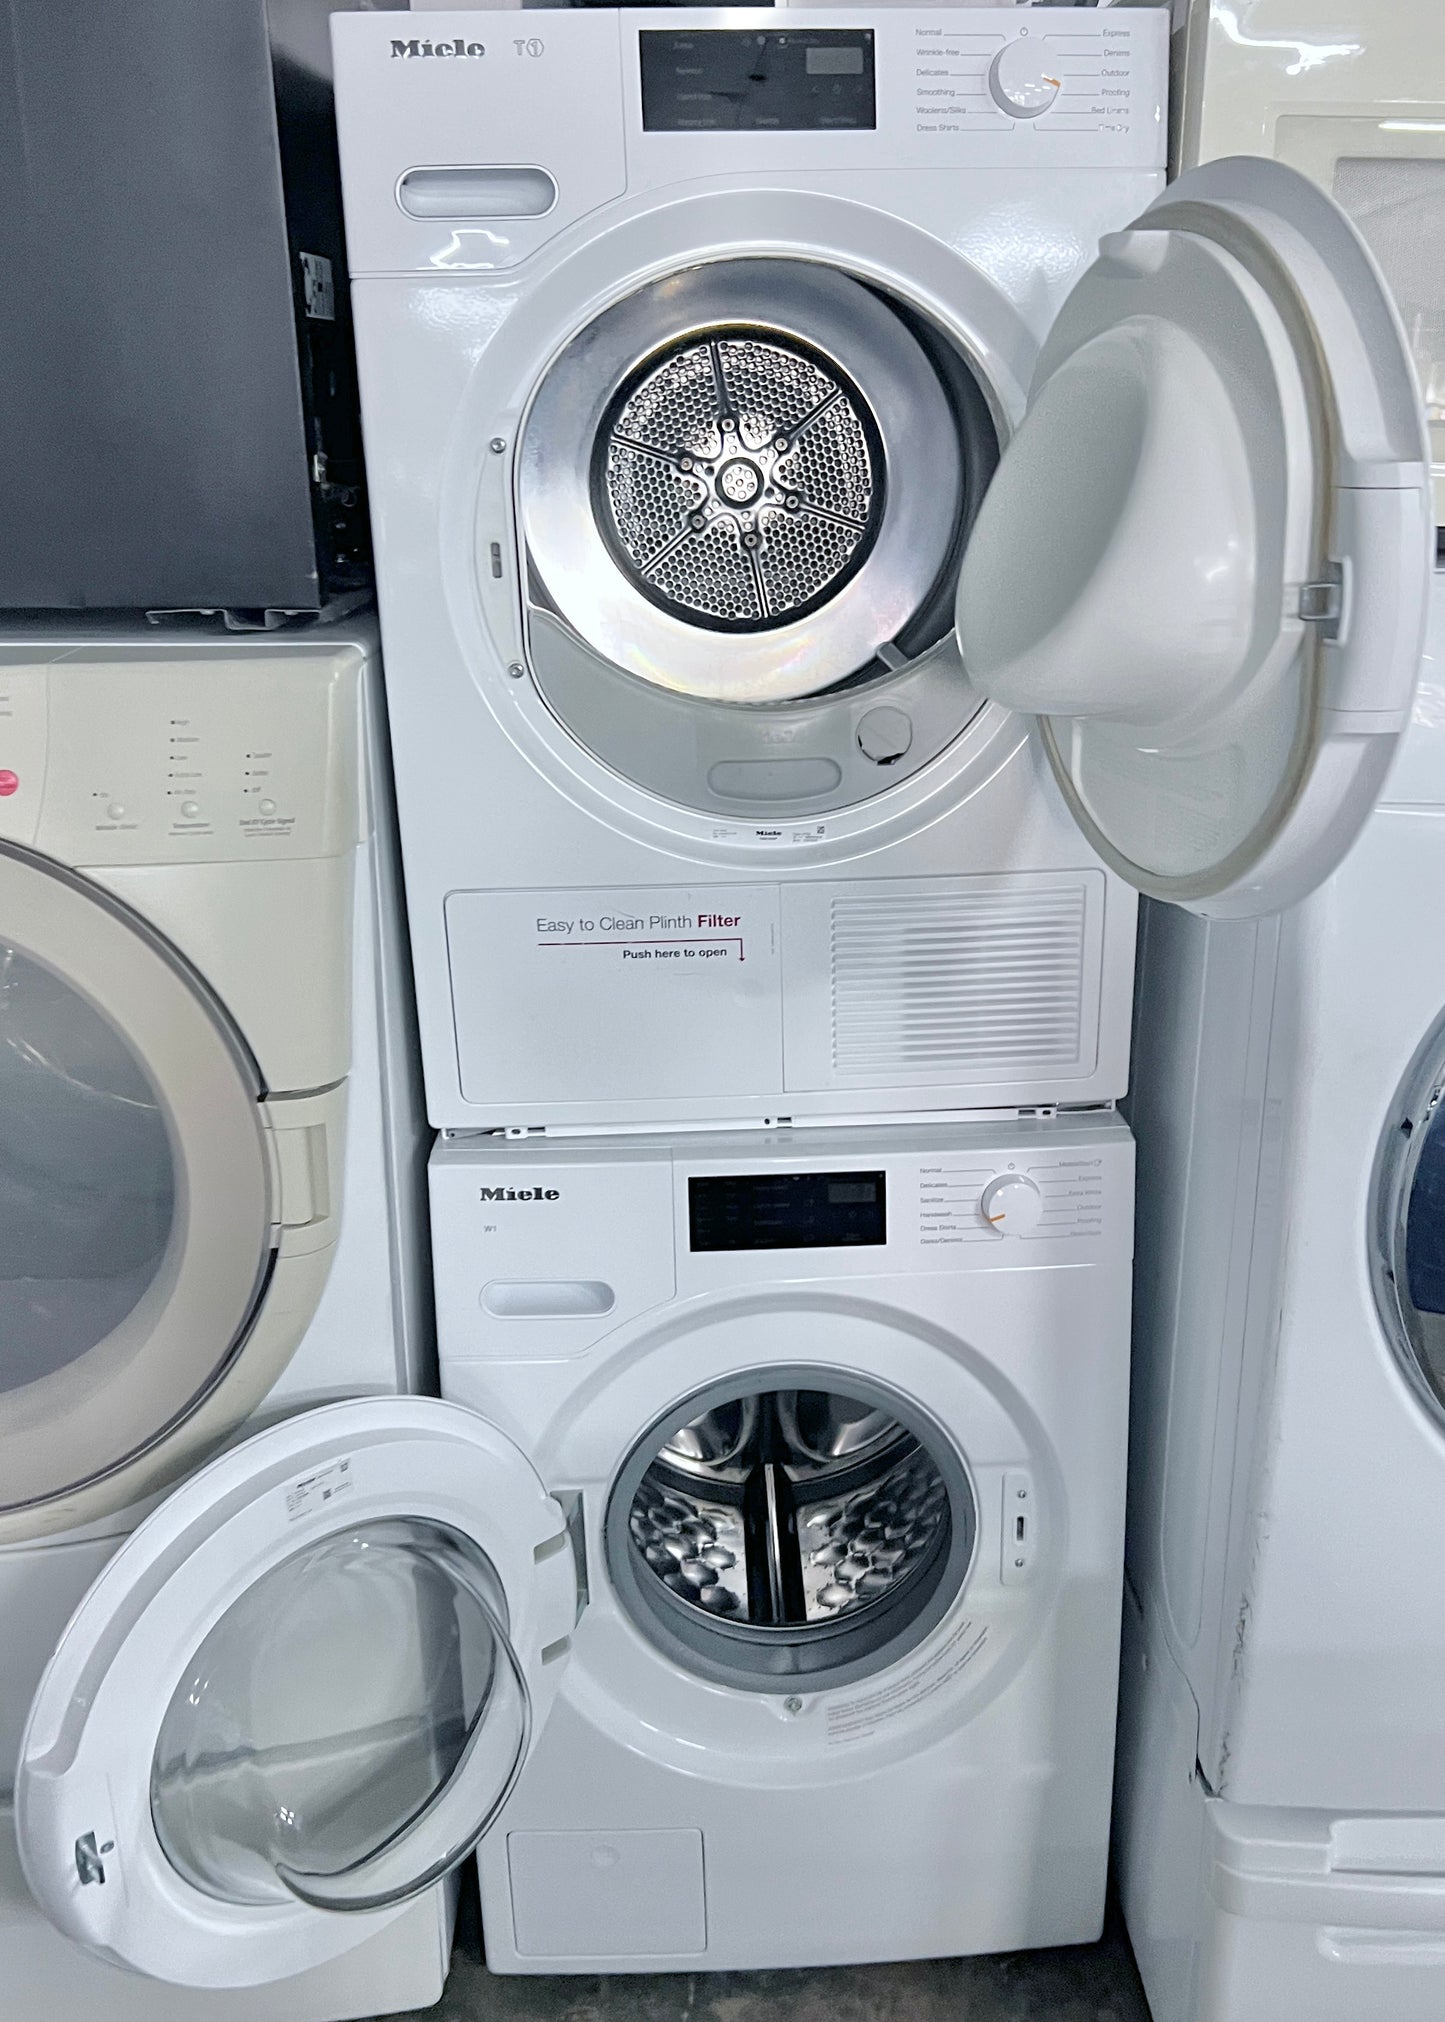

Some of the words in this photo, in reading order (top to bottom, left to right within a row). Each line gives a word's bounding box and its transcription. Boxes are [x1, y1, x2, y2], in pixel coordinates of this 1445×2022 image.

[915, 28, 943, 37] Normal
[1102, 29, 1131, 38] Express
[915, 68, 949, 76] Delicates
[1101, 68, 1130, 77] Outdoor
[916, 87, 956, 97] Smoothing
[537, 918, 574, 935] Easy
[580, 919, 595, 932] to
[599, 916, 644, 931] Clean
[649, 915, 692, 930] Plinth
[698, 914, 742, 928] Filter
[623, 949, 652, 960] Push
[654, 948, 680, 959] here
[683, 948, 695, 958] to
[698, 947, 728, 960] open
[479, 1186, 560, 1203] Miele
